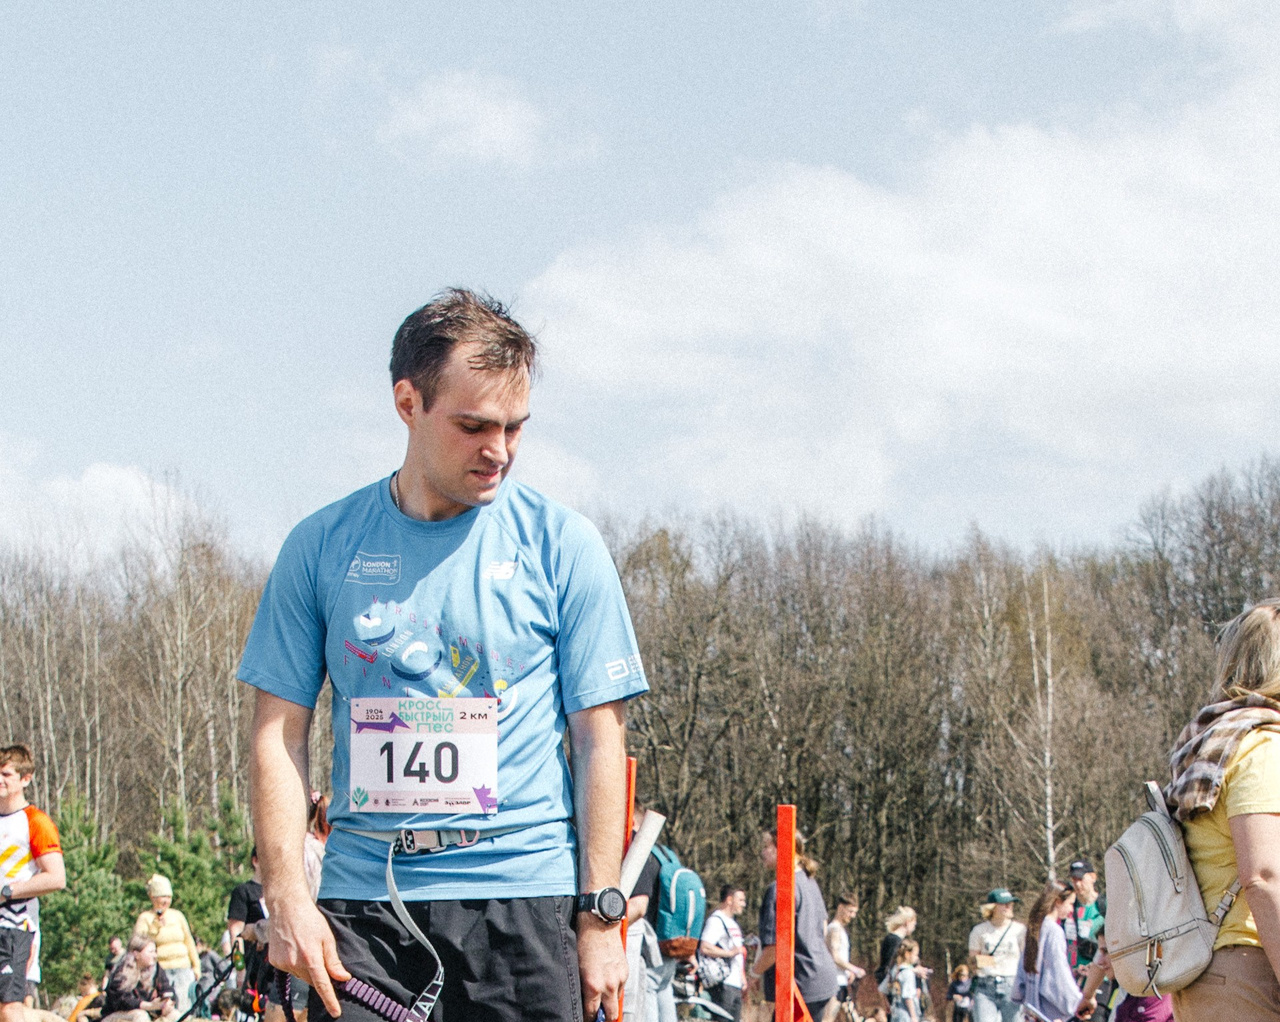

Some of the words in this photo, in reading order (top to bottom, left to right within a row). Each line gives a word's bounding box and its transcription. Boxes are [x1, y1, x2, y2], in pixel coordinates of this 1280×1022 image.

[382, 629, 414, 657] LONDON
[398, 700, 442, 711] КРОСС
[459, 711, 467, 720] 2
[380, 741, 459, 784] 140
